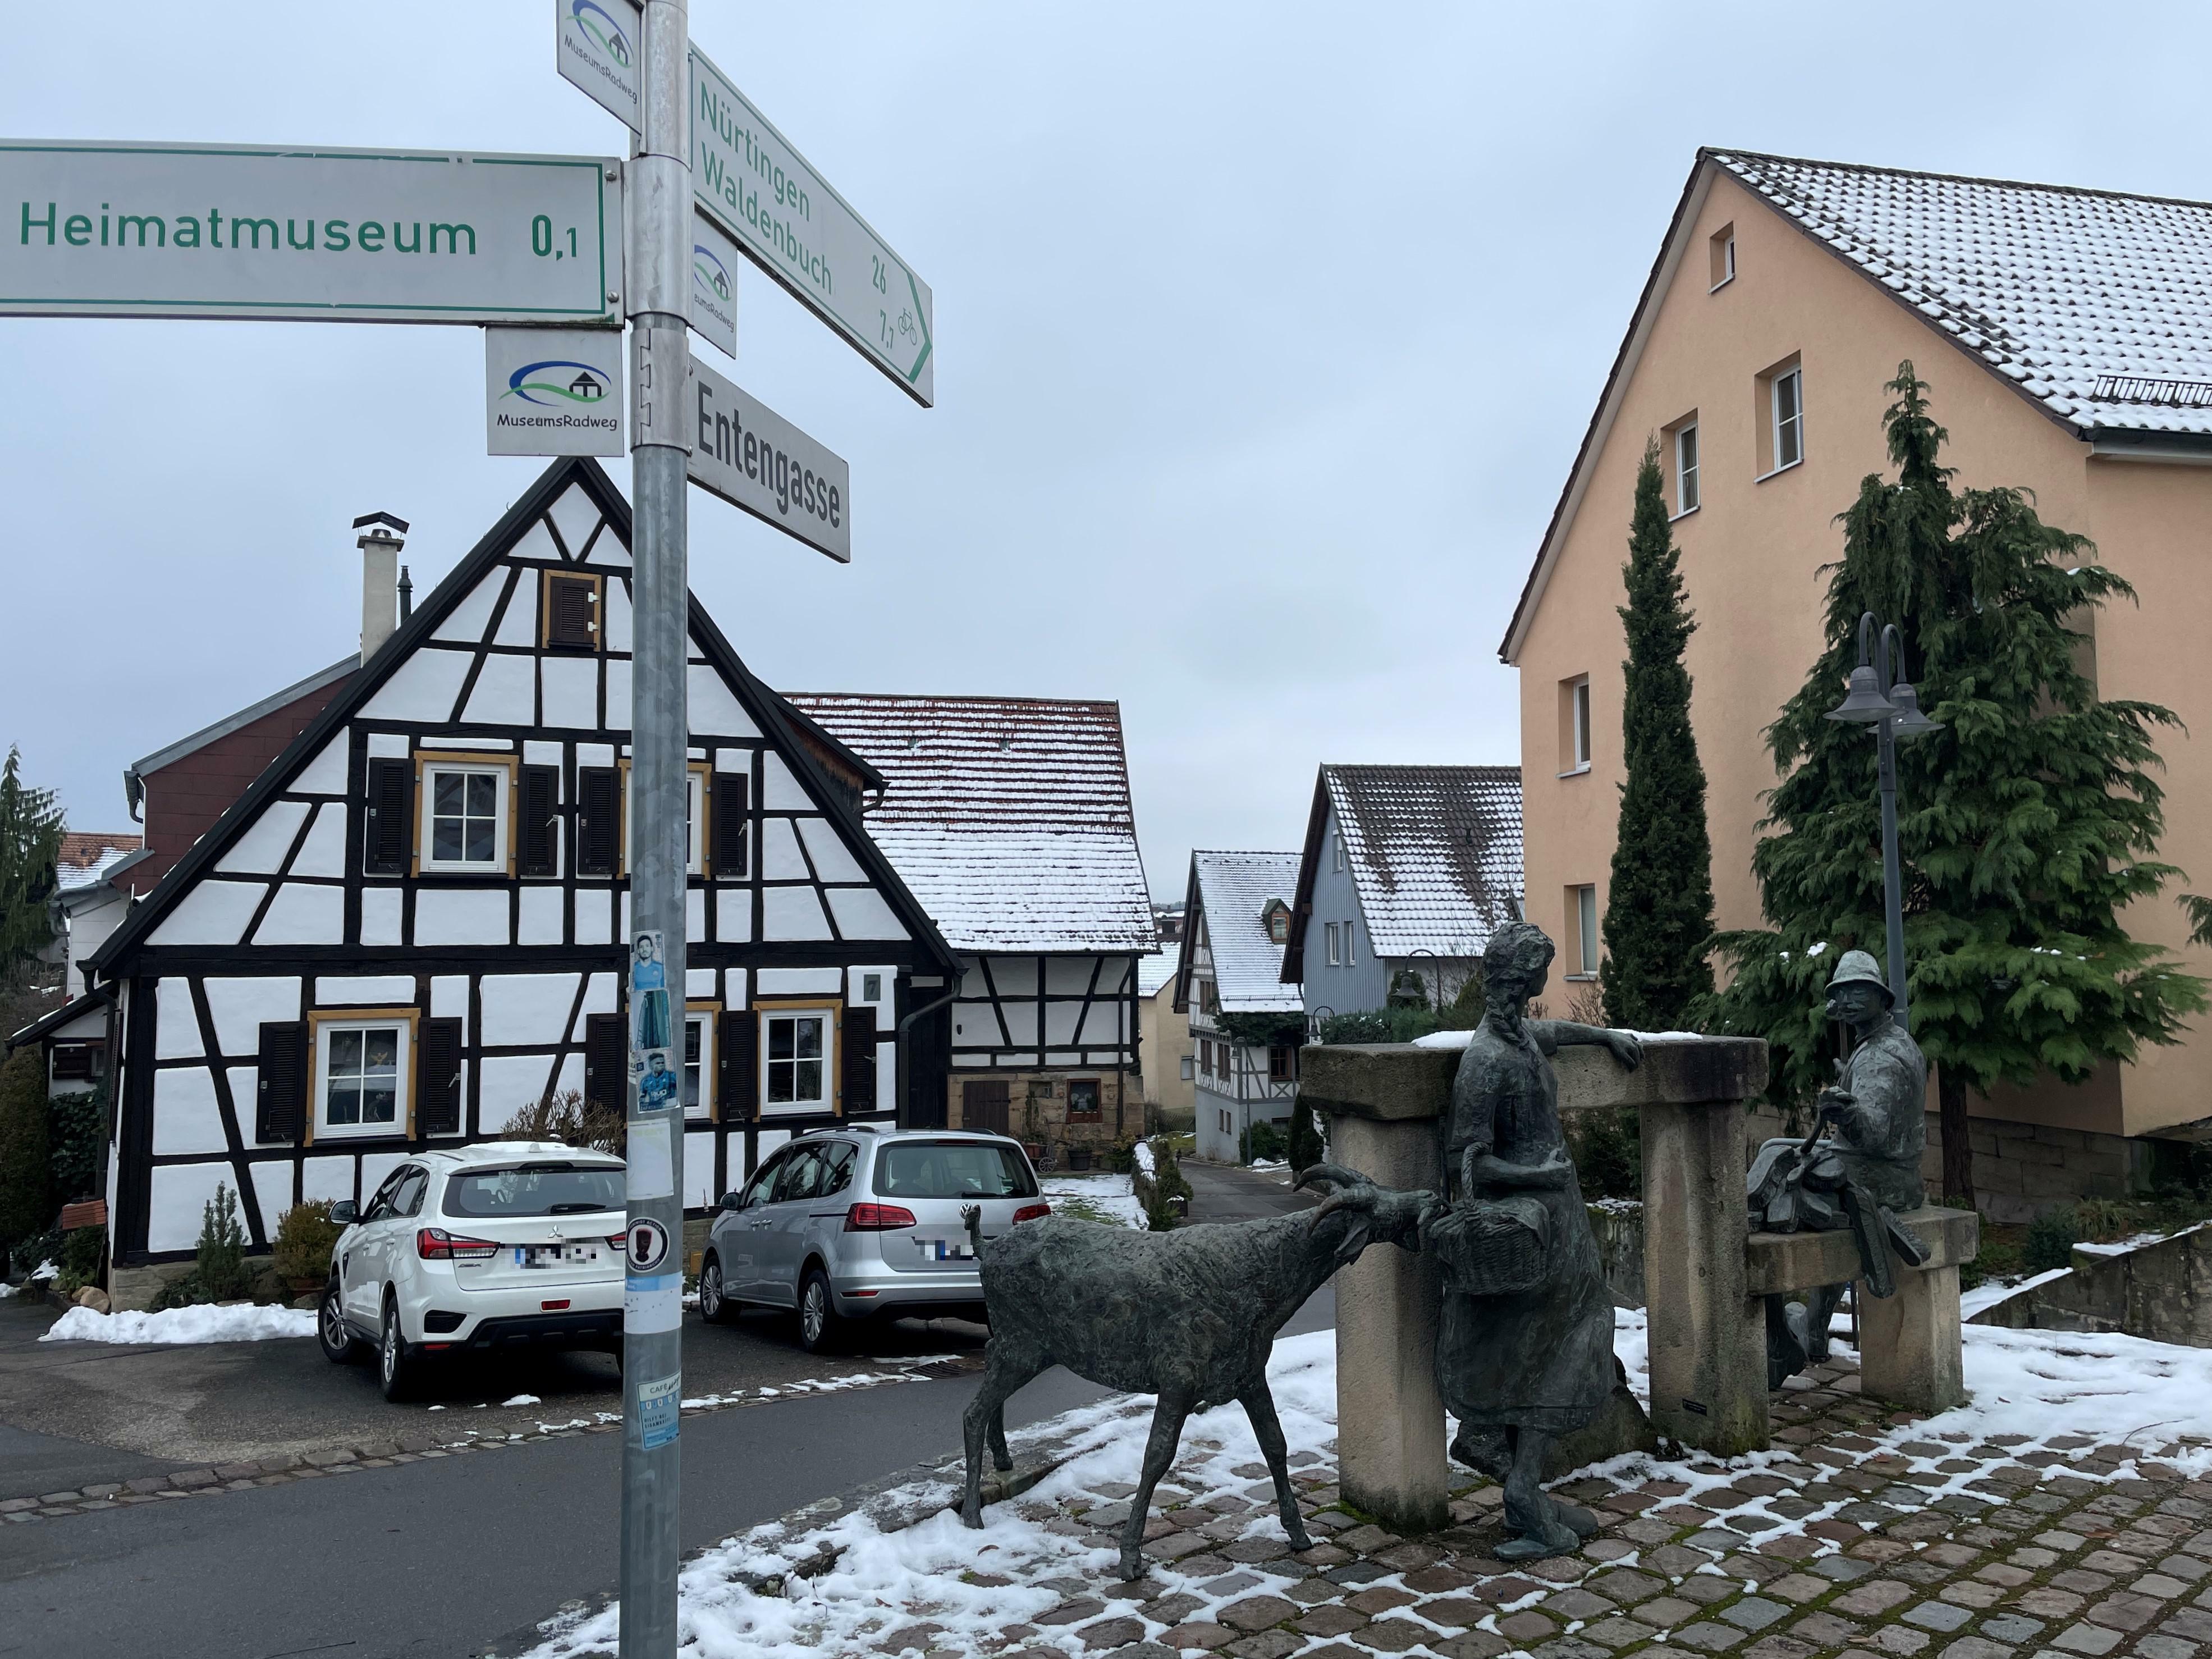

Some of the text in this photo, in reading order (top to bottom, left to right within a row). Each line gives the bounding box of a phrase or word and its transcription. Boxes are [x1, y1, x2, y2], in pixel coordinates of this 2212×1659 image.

[565, 34, 637, 104] MuseumsRadweg
[701, 82, 886, 295] Nürtingen 26
[702, 141, 832, 295] Waldenbuch
[20, 202, 577, 261] Heimatmuseum 0,1
[694, 293, 734, 333] eumsRadweg
[497, 414, 617, 431] MuseumsRadweg
[698, 380, 840, 528] Entengasse
[867, 980, 877, 995] 7
